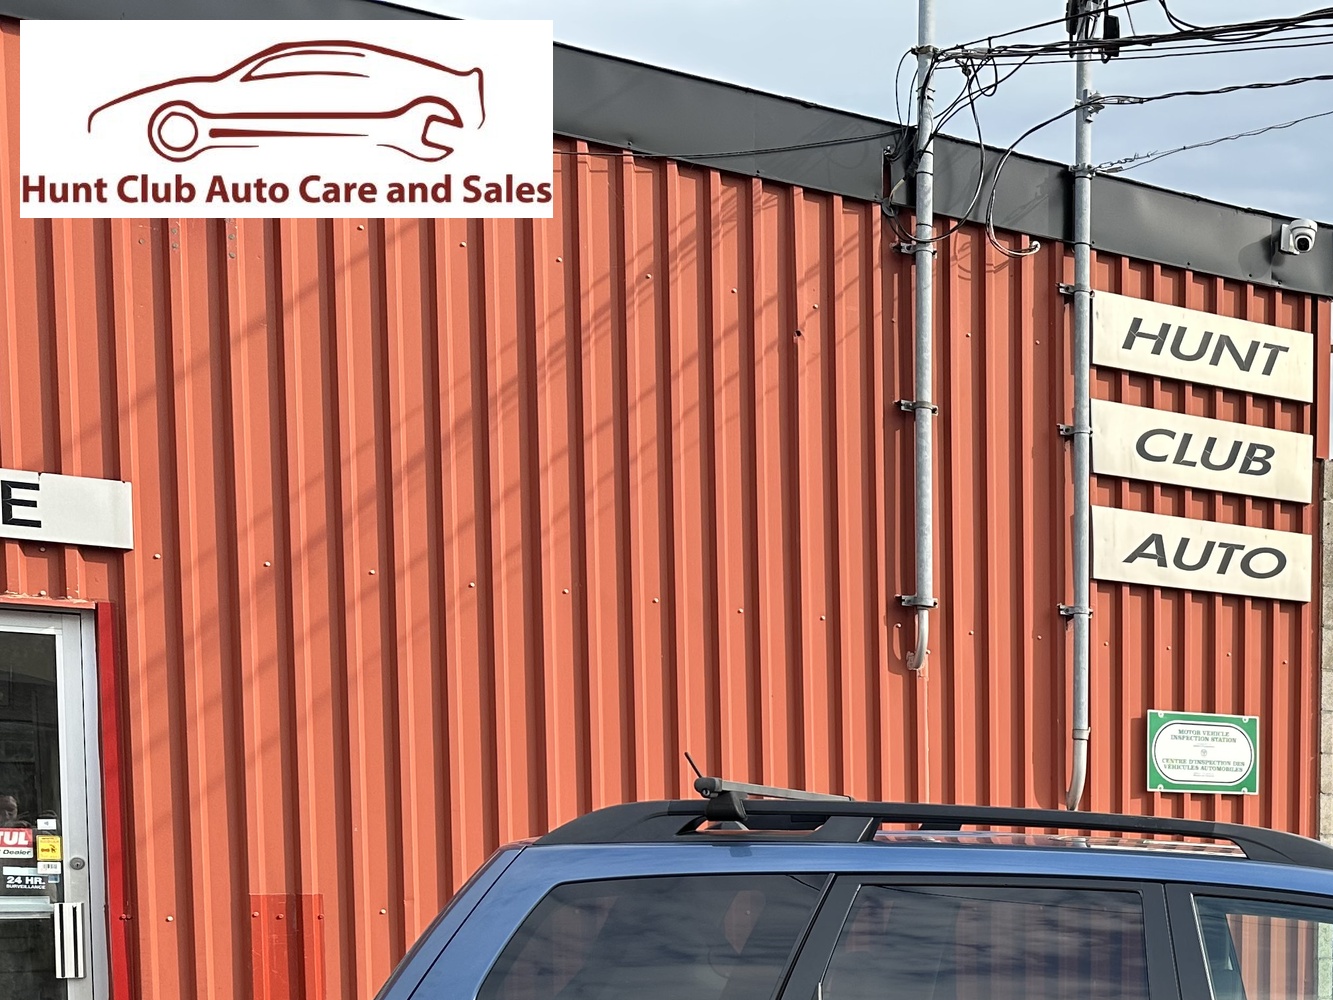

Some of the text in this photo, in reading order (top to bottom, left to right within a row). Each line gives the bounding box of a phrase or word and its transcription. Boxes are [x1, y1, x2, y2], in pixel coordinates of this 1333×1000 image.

[1121, 316, 1290, 376] HUNT
[1135, 428, 1276, 477] CLUB
[1122, 532, 1288, 580] AUTO
[6, 876, 46, 885] 24 HR.
